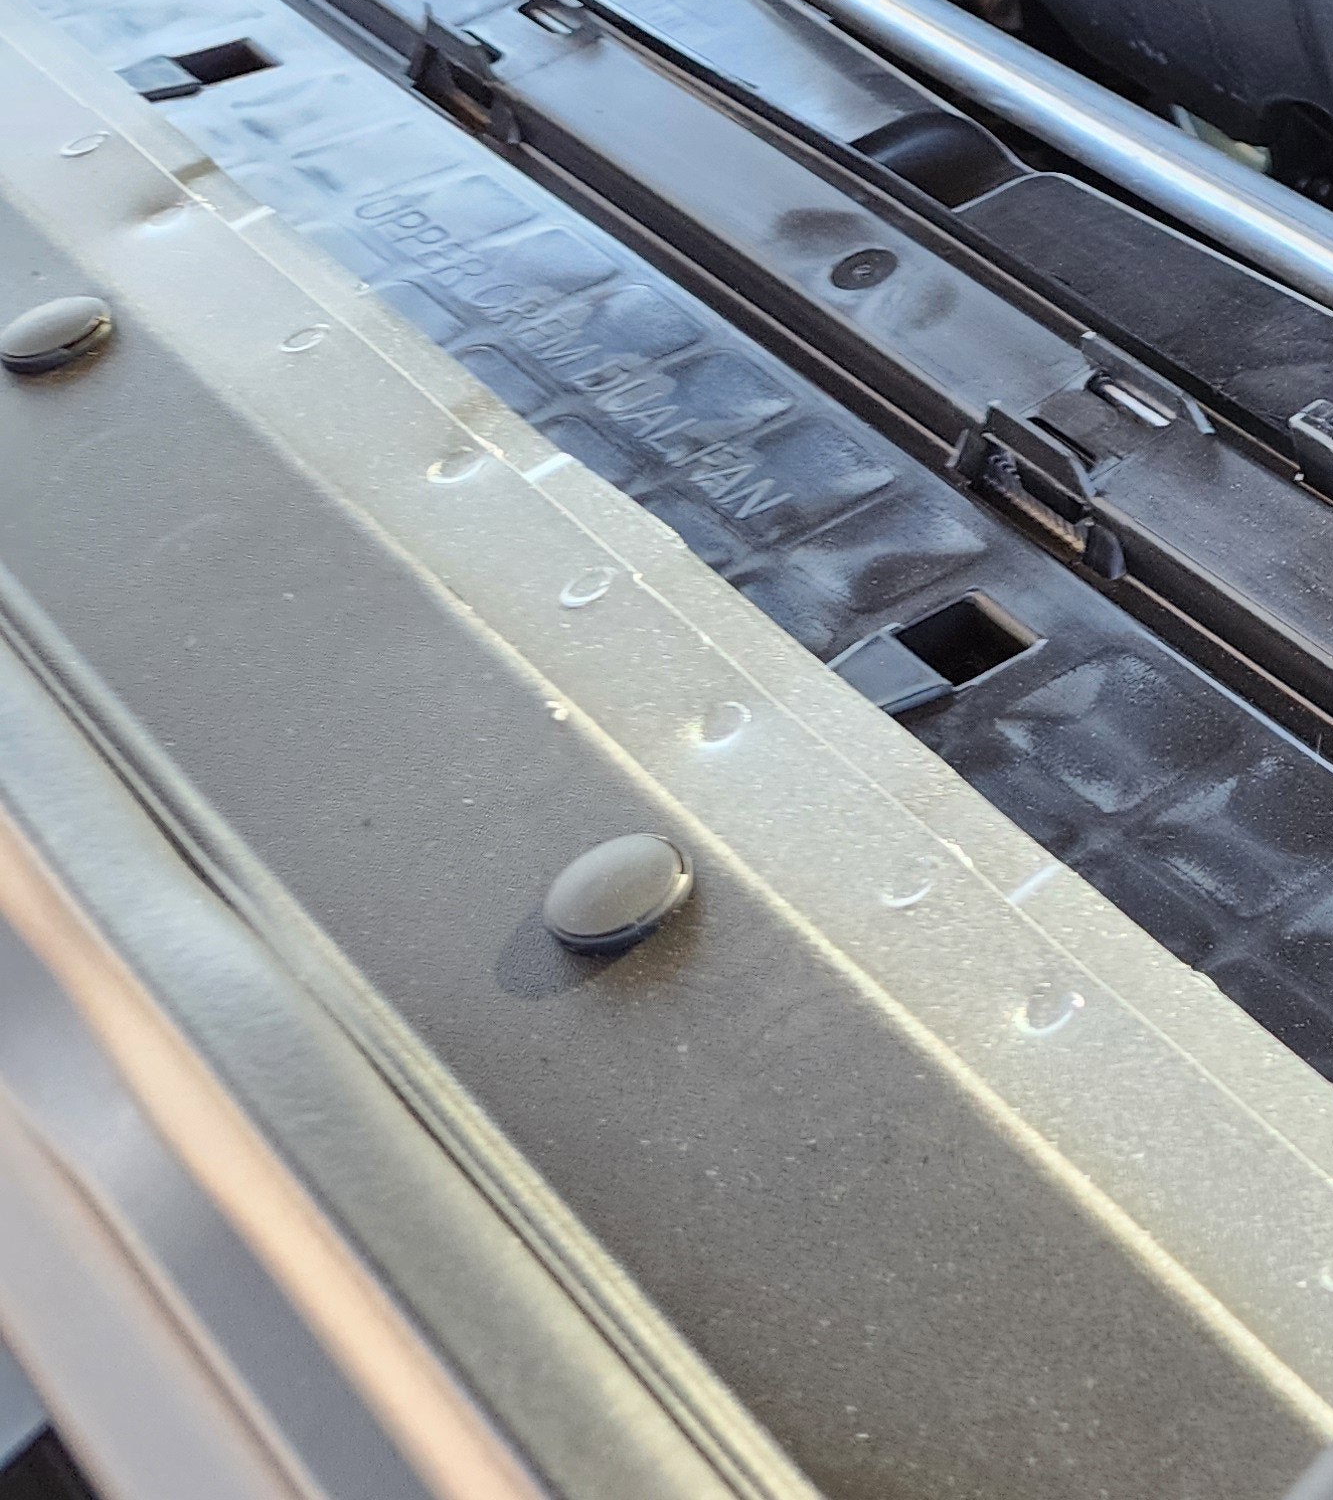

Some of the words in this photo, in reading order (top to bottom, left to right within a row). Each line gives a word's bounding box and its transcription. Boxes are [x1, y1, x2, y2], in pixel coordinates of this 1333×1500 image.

[355, 195, 492, 288] UPPER
[567, 358, 699, 464] DUAL
[671, 440, 796, 520] FAN
